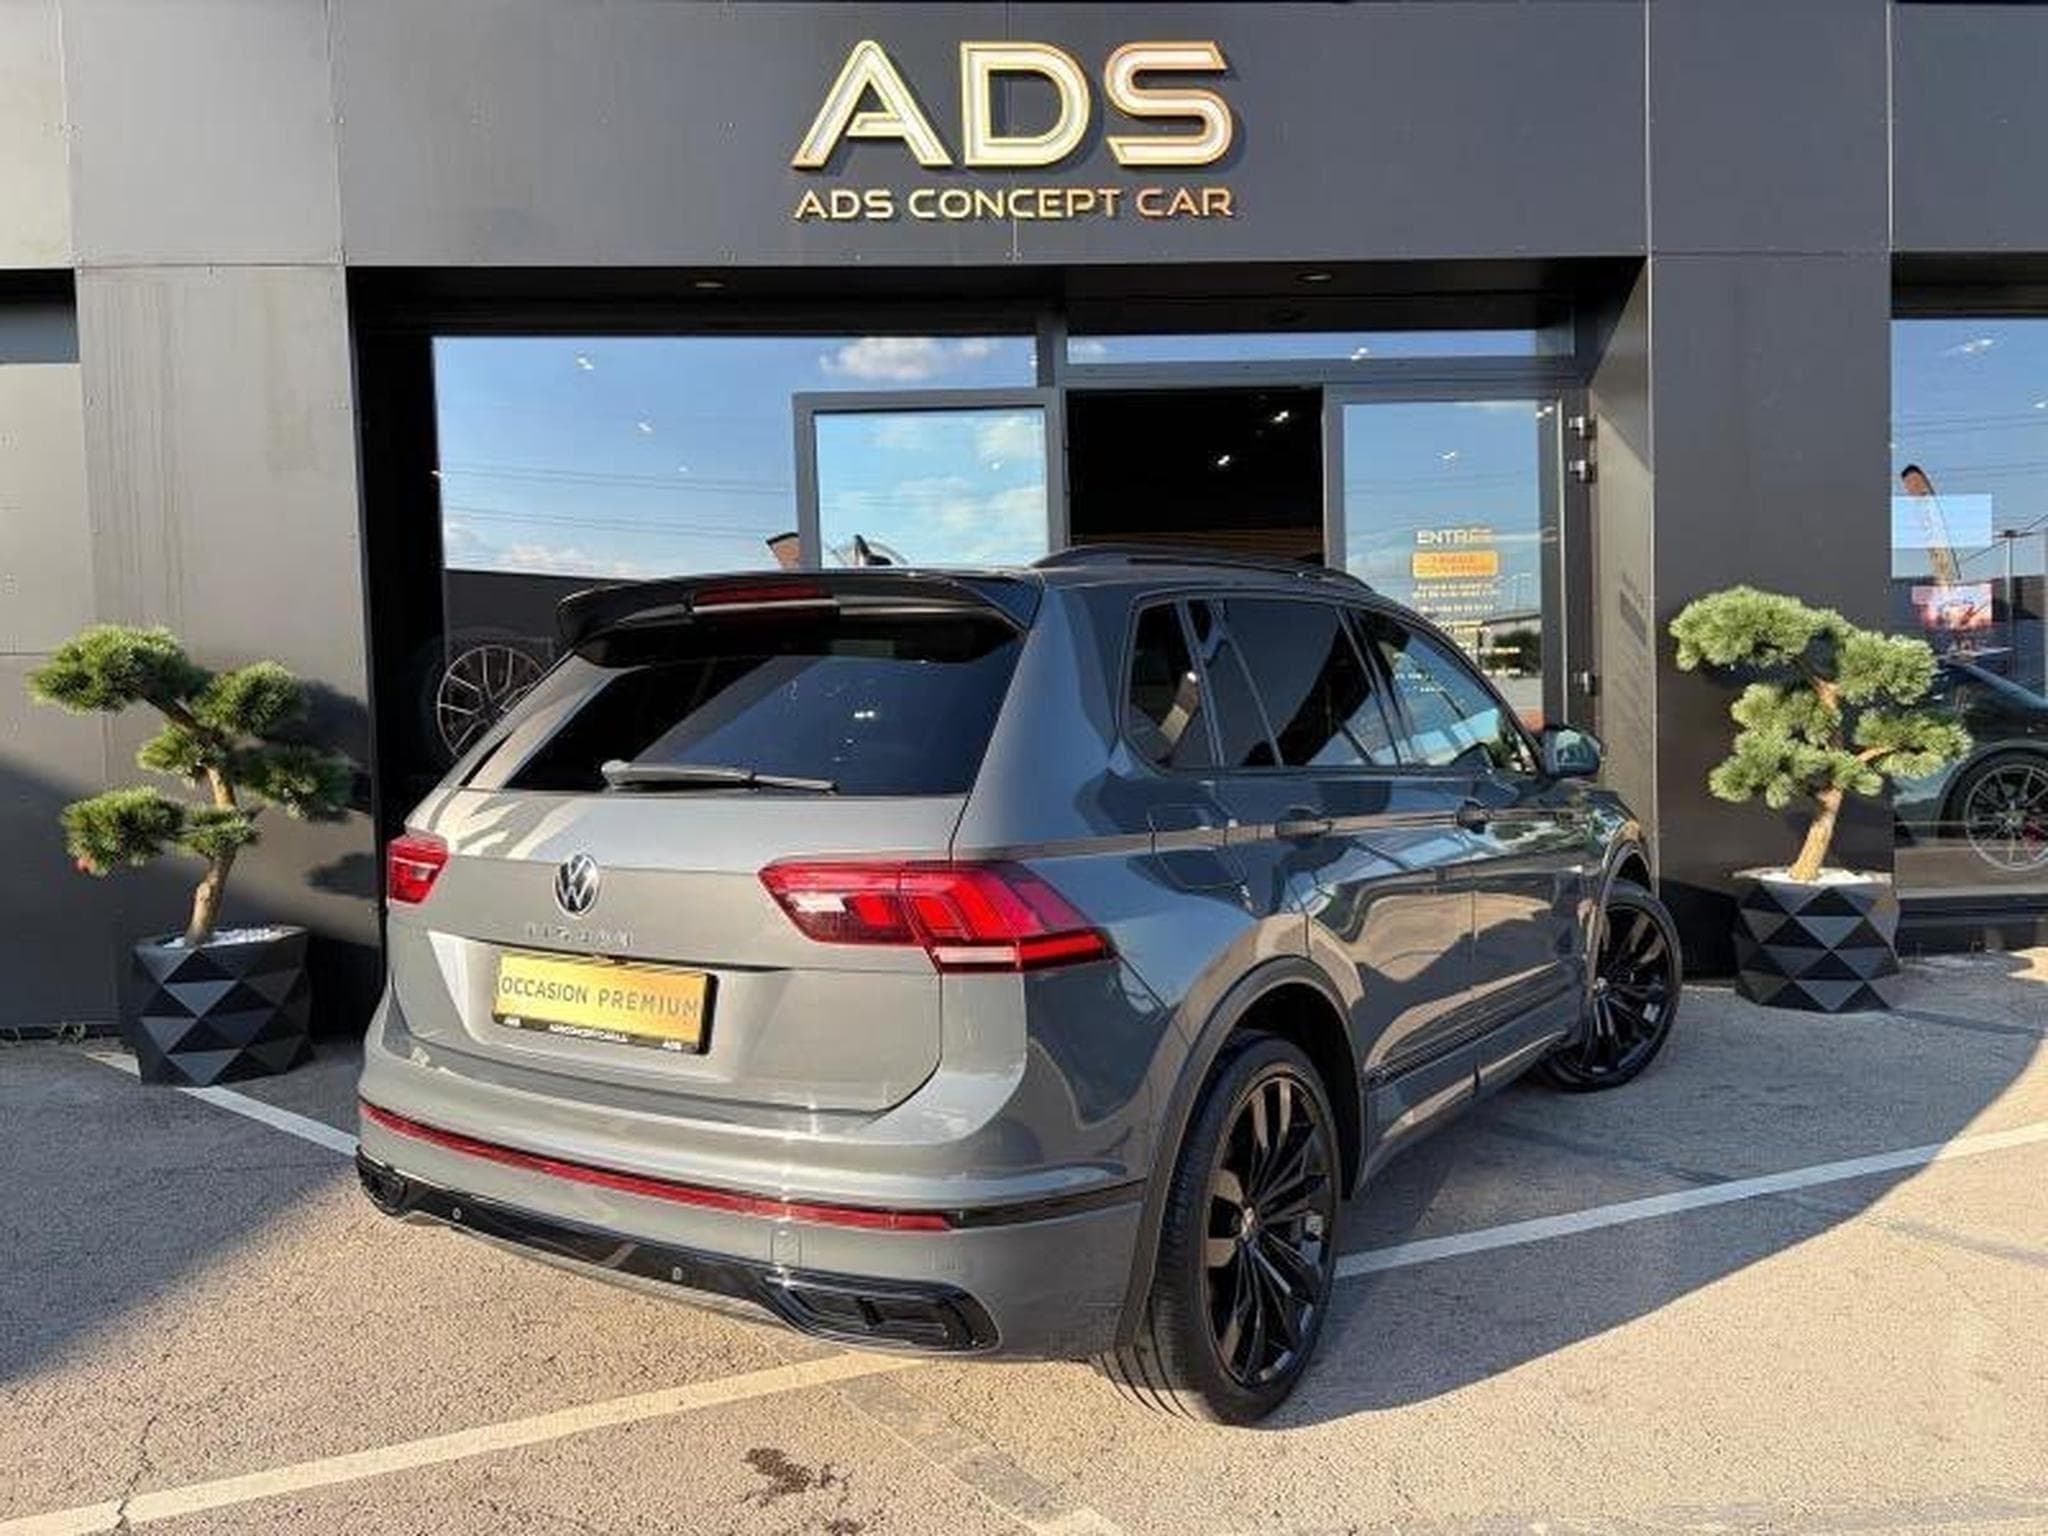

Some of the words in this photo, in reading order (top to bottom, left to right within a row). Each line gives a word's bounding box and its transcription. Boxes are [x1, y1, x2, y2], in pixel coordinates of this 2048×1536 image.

[791, 39, 1233, 167] ADS
[793, 189, 895, 219] ADS
[908, 188, 1122, 219] CONCEPT
[1136, 187, 1233, 217] CAR
[500, 974, 588, 1006] OCCASION
[598, 986, 698, 1019] PREMIUM
